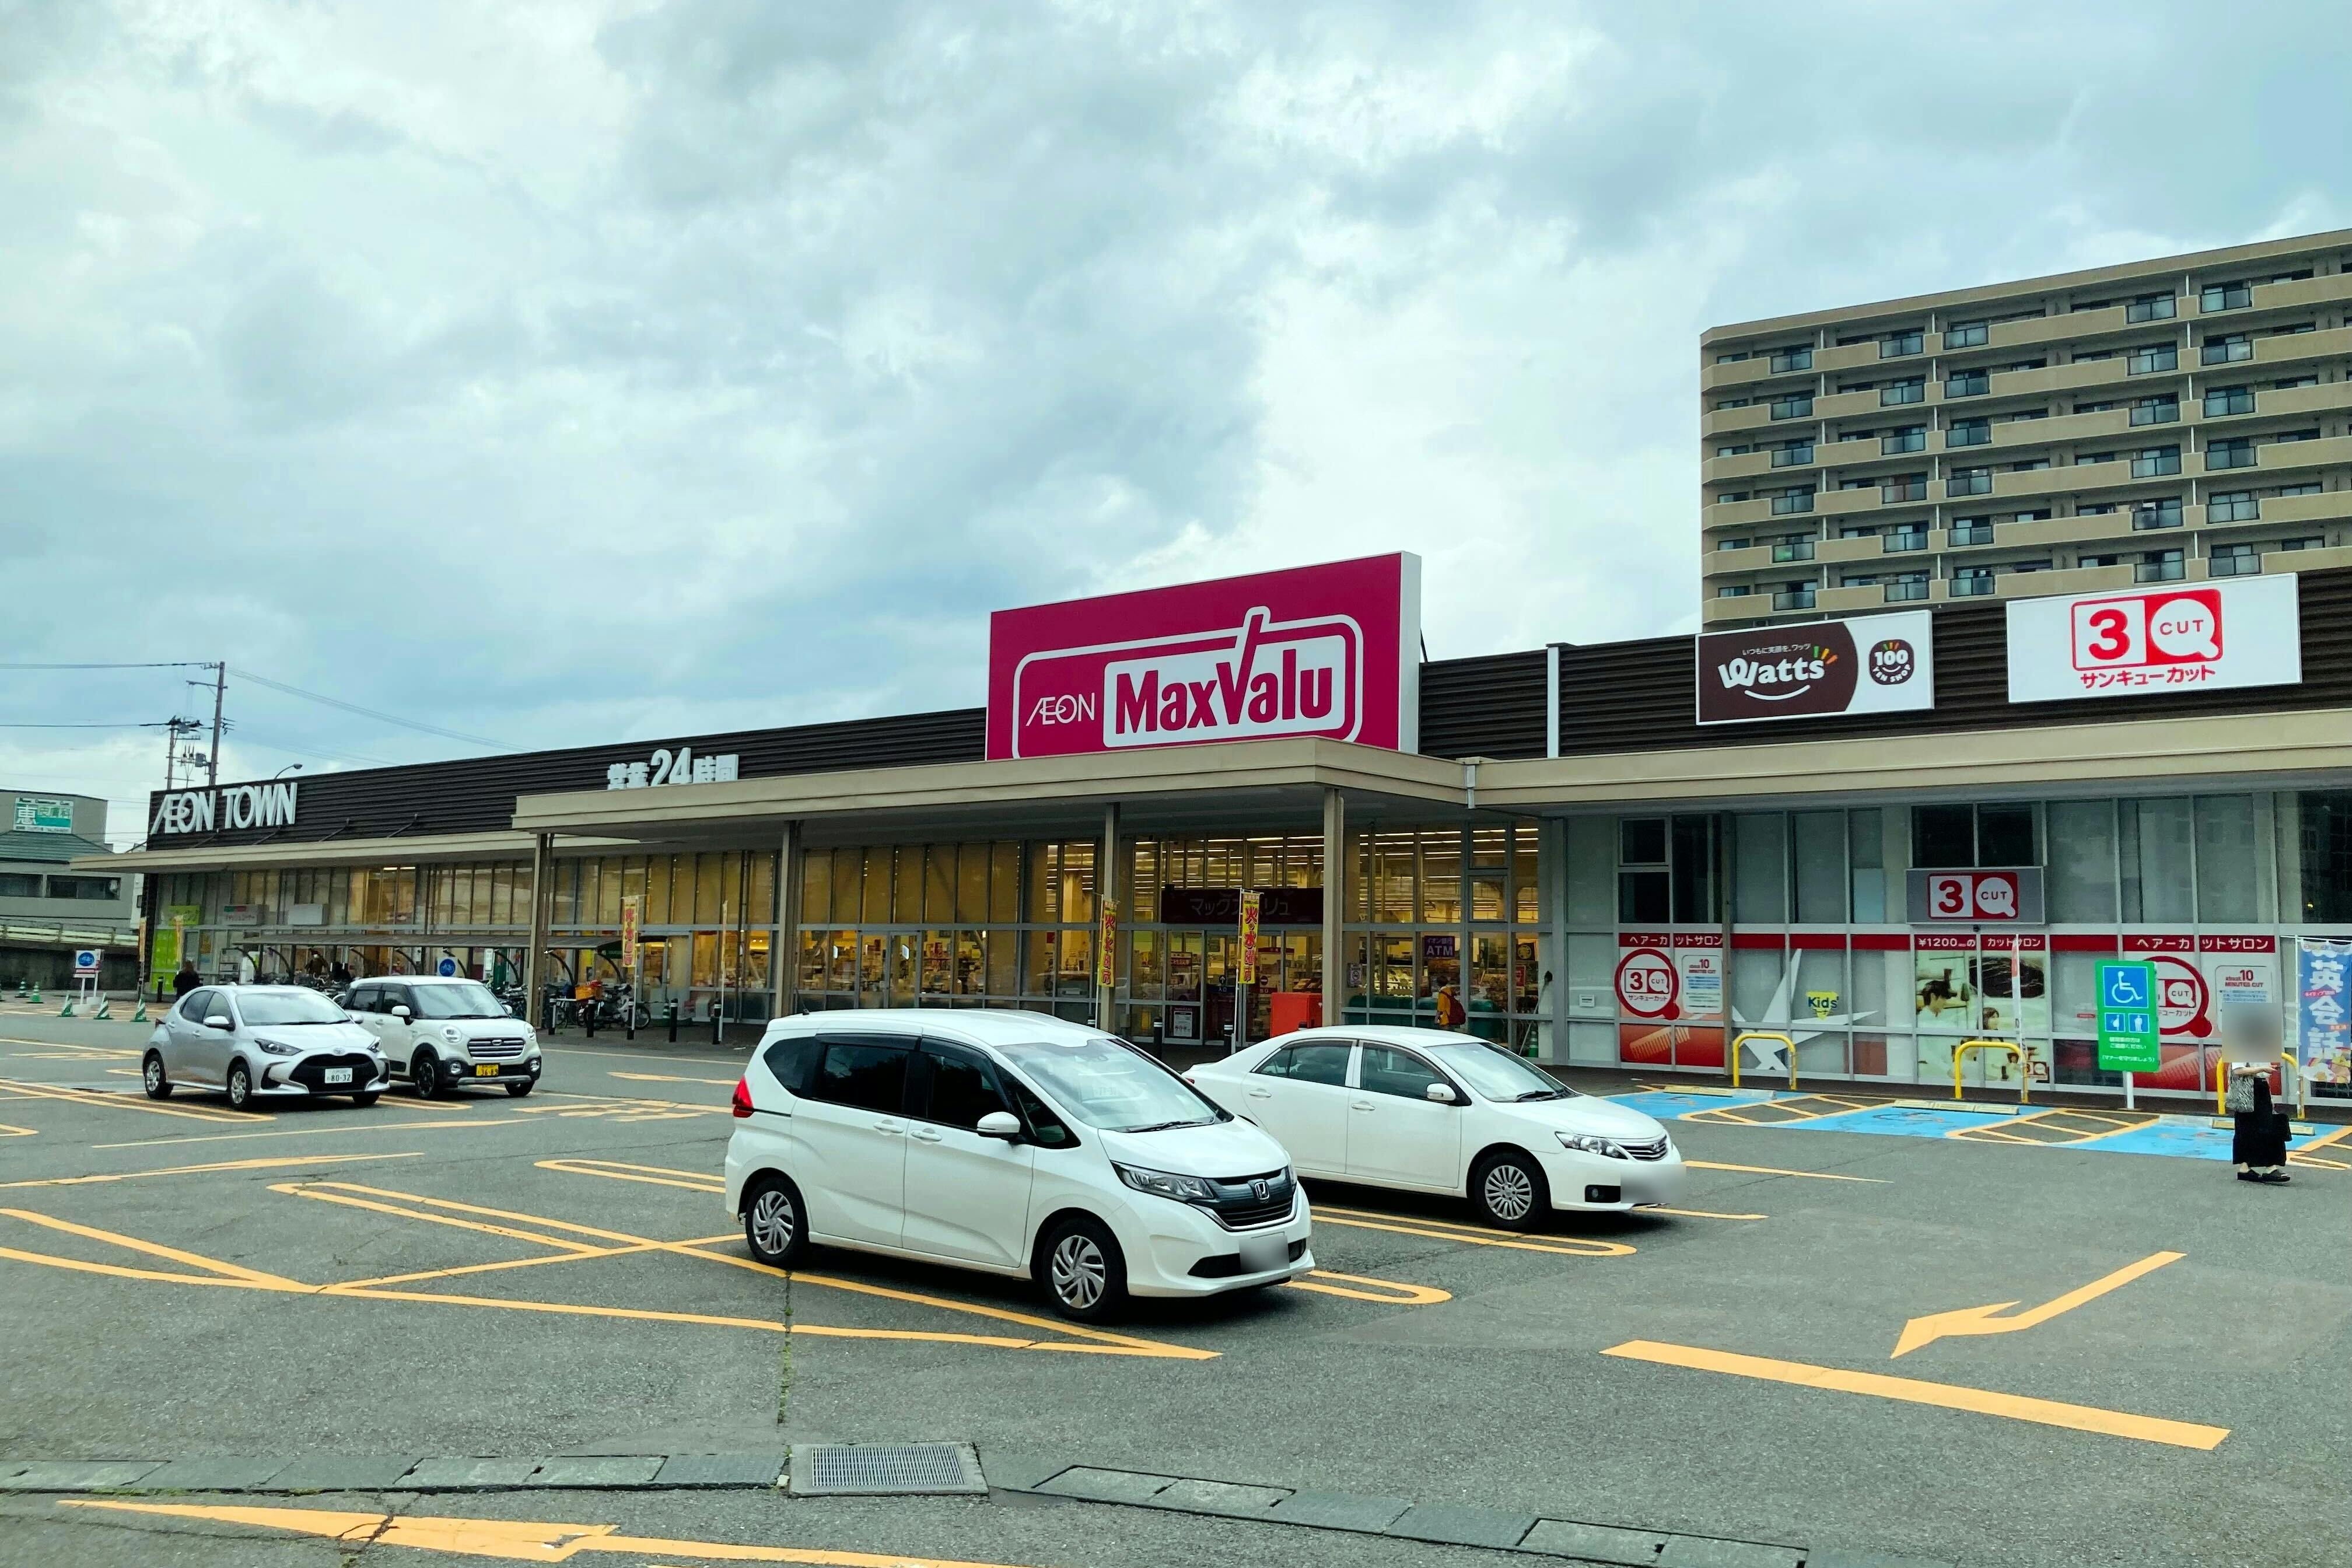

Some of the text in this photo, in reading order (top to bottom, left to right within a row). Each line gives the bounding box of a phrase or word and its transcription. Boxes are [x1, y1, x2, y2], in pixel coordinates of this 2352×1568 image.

[2088, 608, 2130, 660] 3
[2160, 620, 2204, 635] CUT
[1874, 649, 1909, 666] 100
[1116, 614, 1332, 734] MaxValu
[1717, 657, 1825, 689] Watts
[1873, 664, 1911, 682] YEN SHOP
[2080, 664, 2216, 689] サンキューカット
[222, 782, 298, 830] TOWN
[1938, 880, 1964, 914] 3
[1981, 891, 2007, 900] CUT
[1189, 897, 1292, 916] マックリュ
[1426, 945, 1453, 956] ATM
[1699, 958, 1710, 969] 10
[1630, 972, 1643, 990] 3
[2239, 970, 2253, 981] 10
